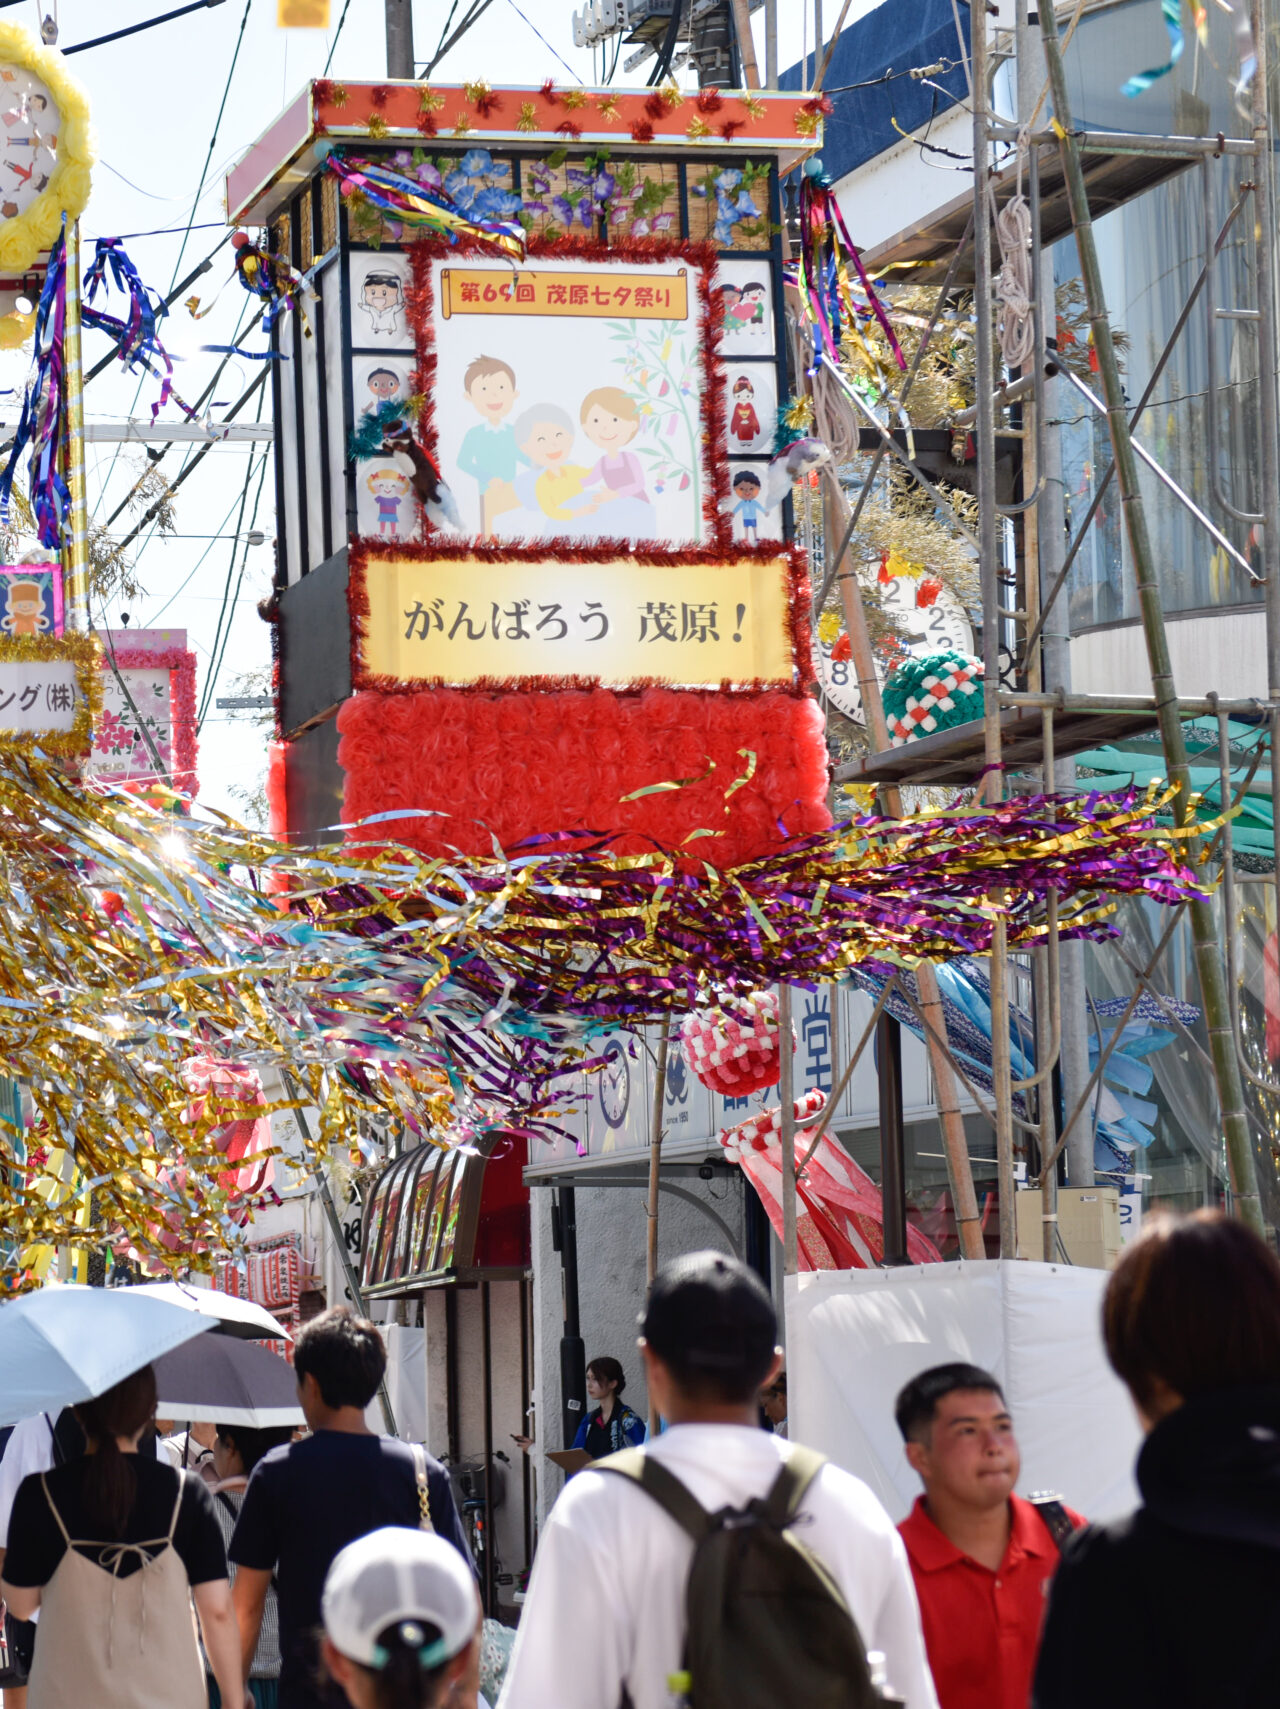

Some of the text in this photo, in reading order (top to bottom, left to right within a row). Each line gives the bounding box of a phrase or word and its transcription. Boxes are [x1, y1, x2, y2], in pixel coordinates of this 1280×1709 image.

[460, 281, 671, 308] 第69回 茂原七夕祭り
[403, 597, 747, 644] がんばろう 茂原！
[928, 606, 946, 631] 2
[830, 661, 849, 686] 8
